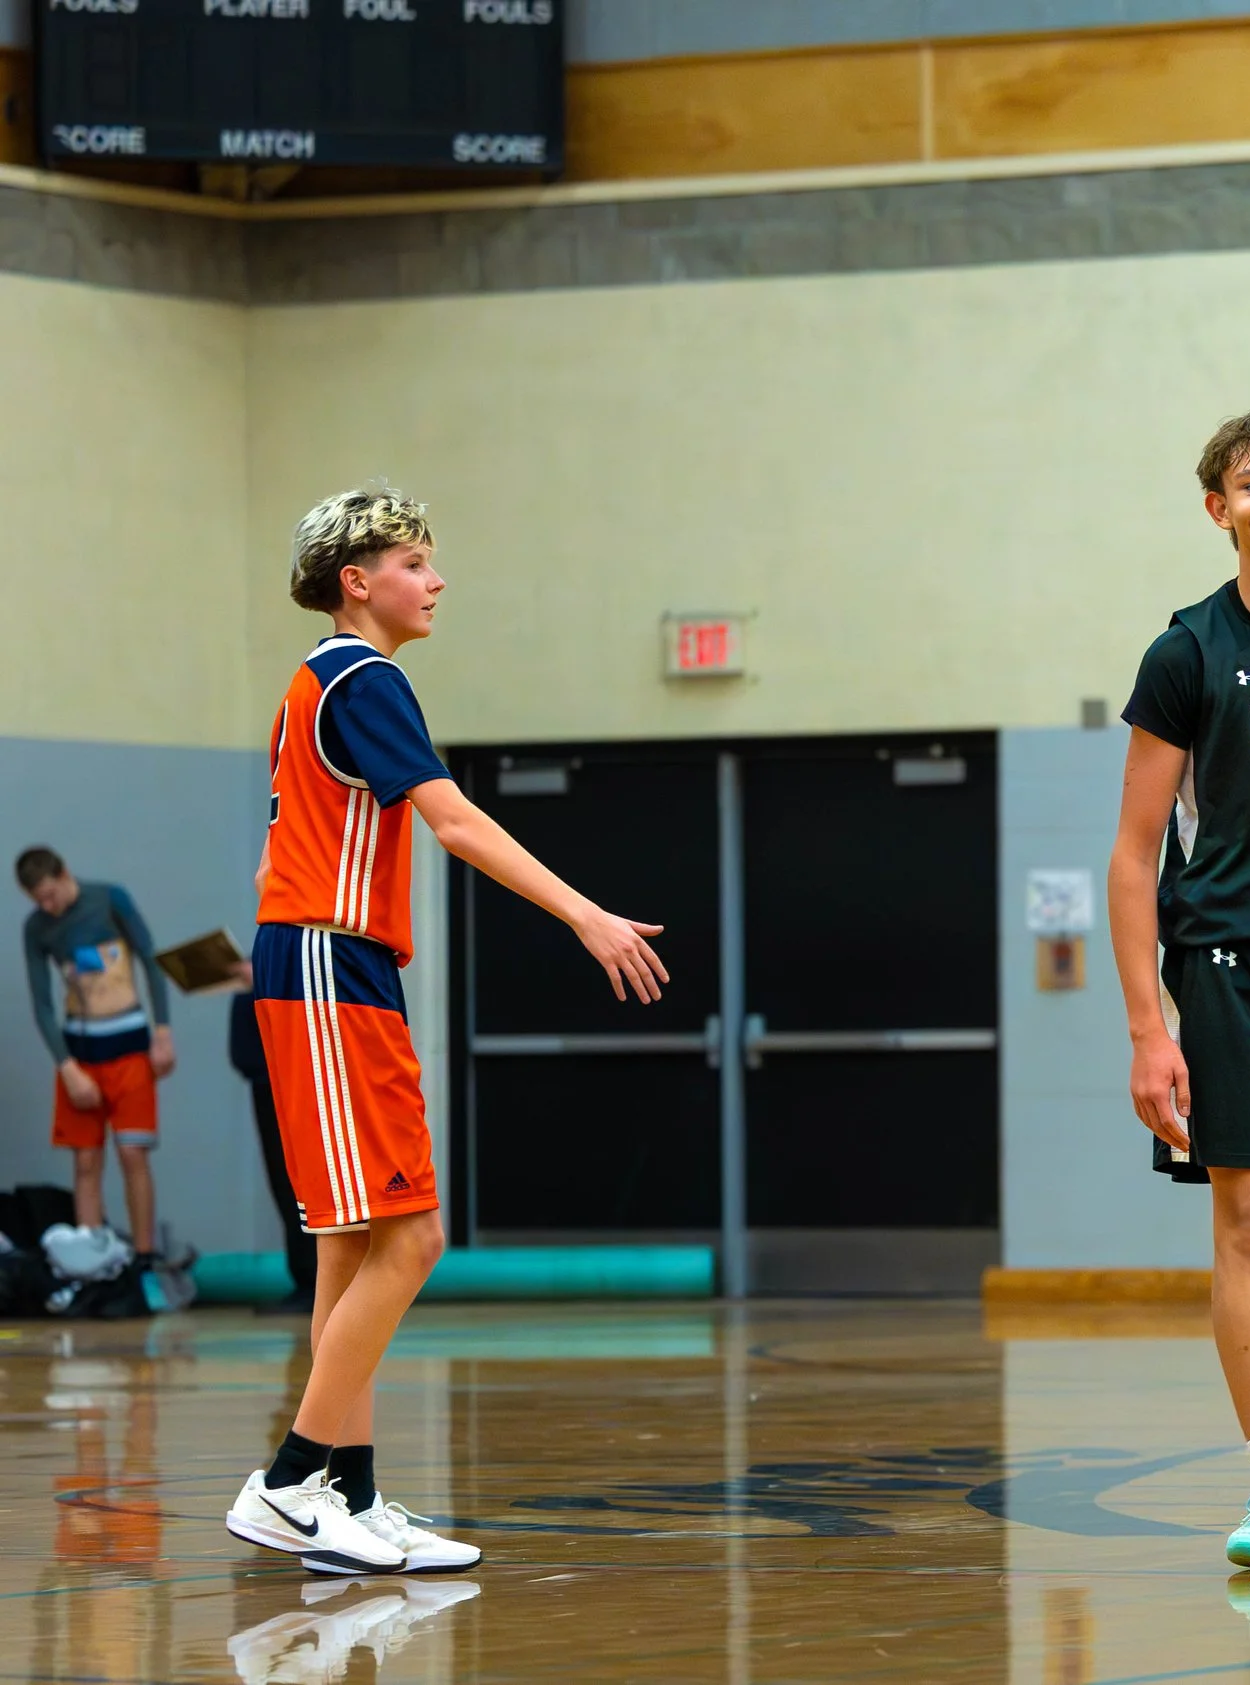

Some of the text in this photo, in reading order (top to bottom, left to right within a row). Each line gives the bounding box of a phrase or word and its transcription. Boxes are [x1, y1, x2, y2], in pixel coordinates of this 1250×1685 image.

[343, 0, 417, 21] FOUL
[463, 0, 553, 25] FOULS
[220, 129, 315, 158] MATCH
[453, 133, 547, 163] SCORE
